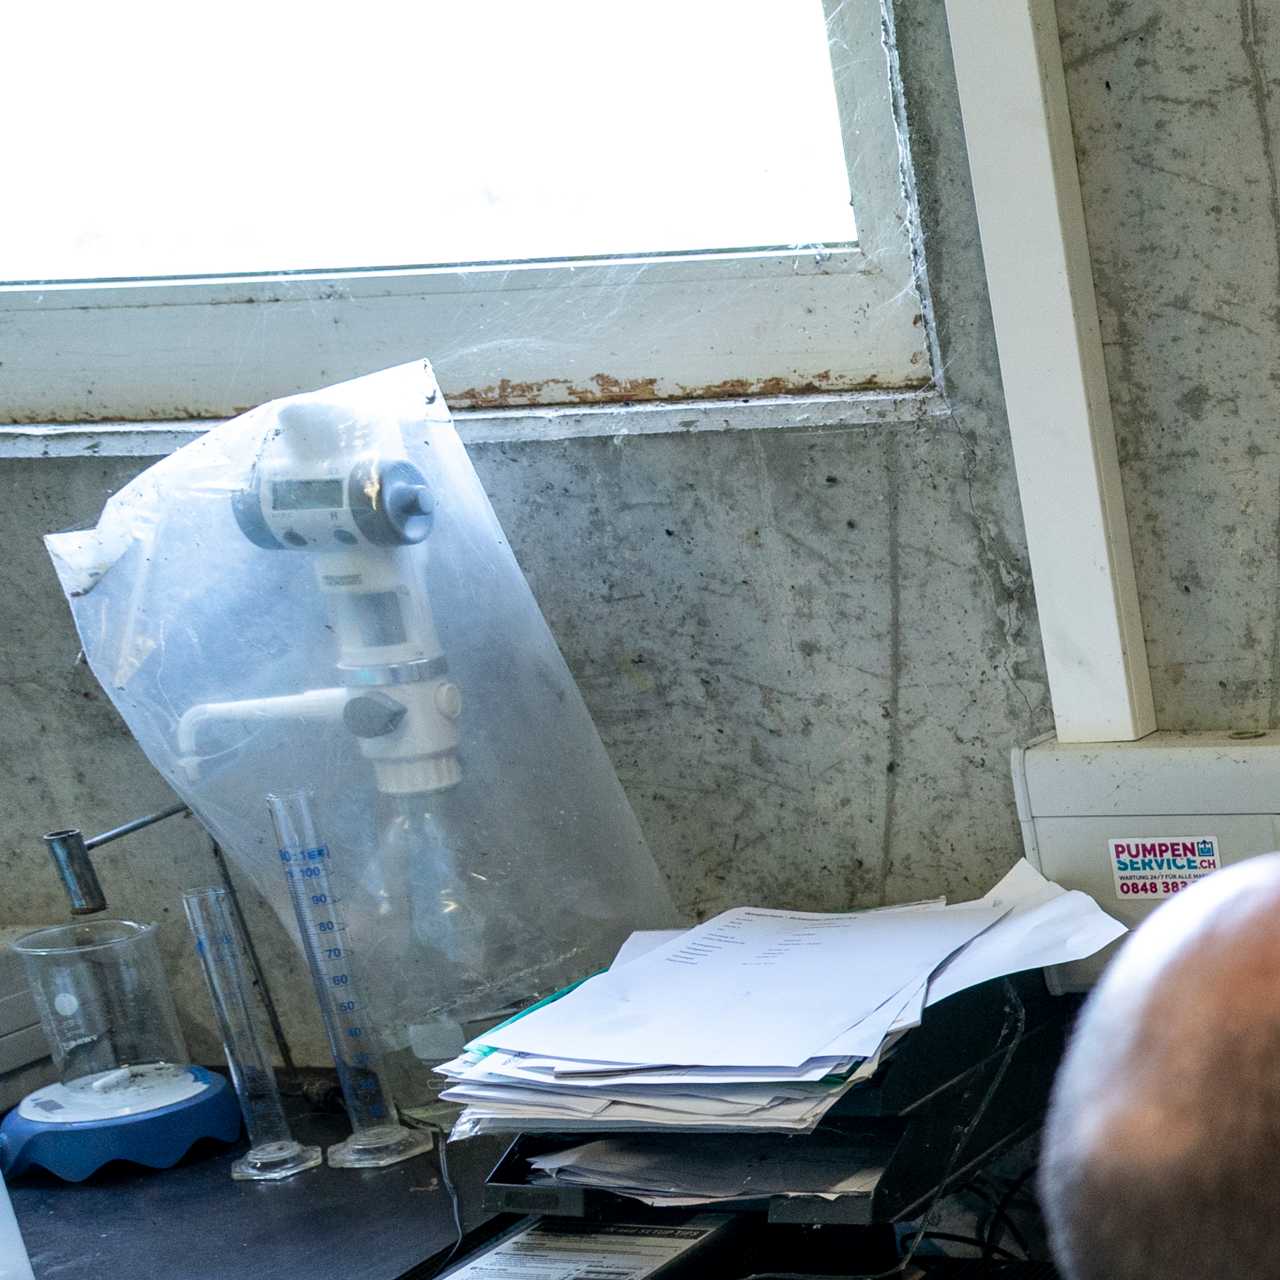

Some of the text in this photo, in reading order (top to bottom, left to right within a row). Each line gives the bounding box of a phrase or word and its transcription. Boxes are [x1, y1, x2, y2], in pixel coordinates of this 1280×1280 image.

[1114, 842, 1197, 859] PUMPEN
[300, 867, 321, 879] 100
[1120, 883, 1158, 894] 0848
[312, 893, 327, 904] 90
[319, 921, 334, 931] 80
[326, 948, 341, 958] 70
[332, 974, 348, 985] 60
